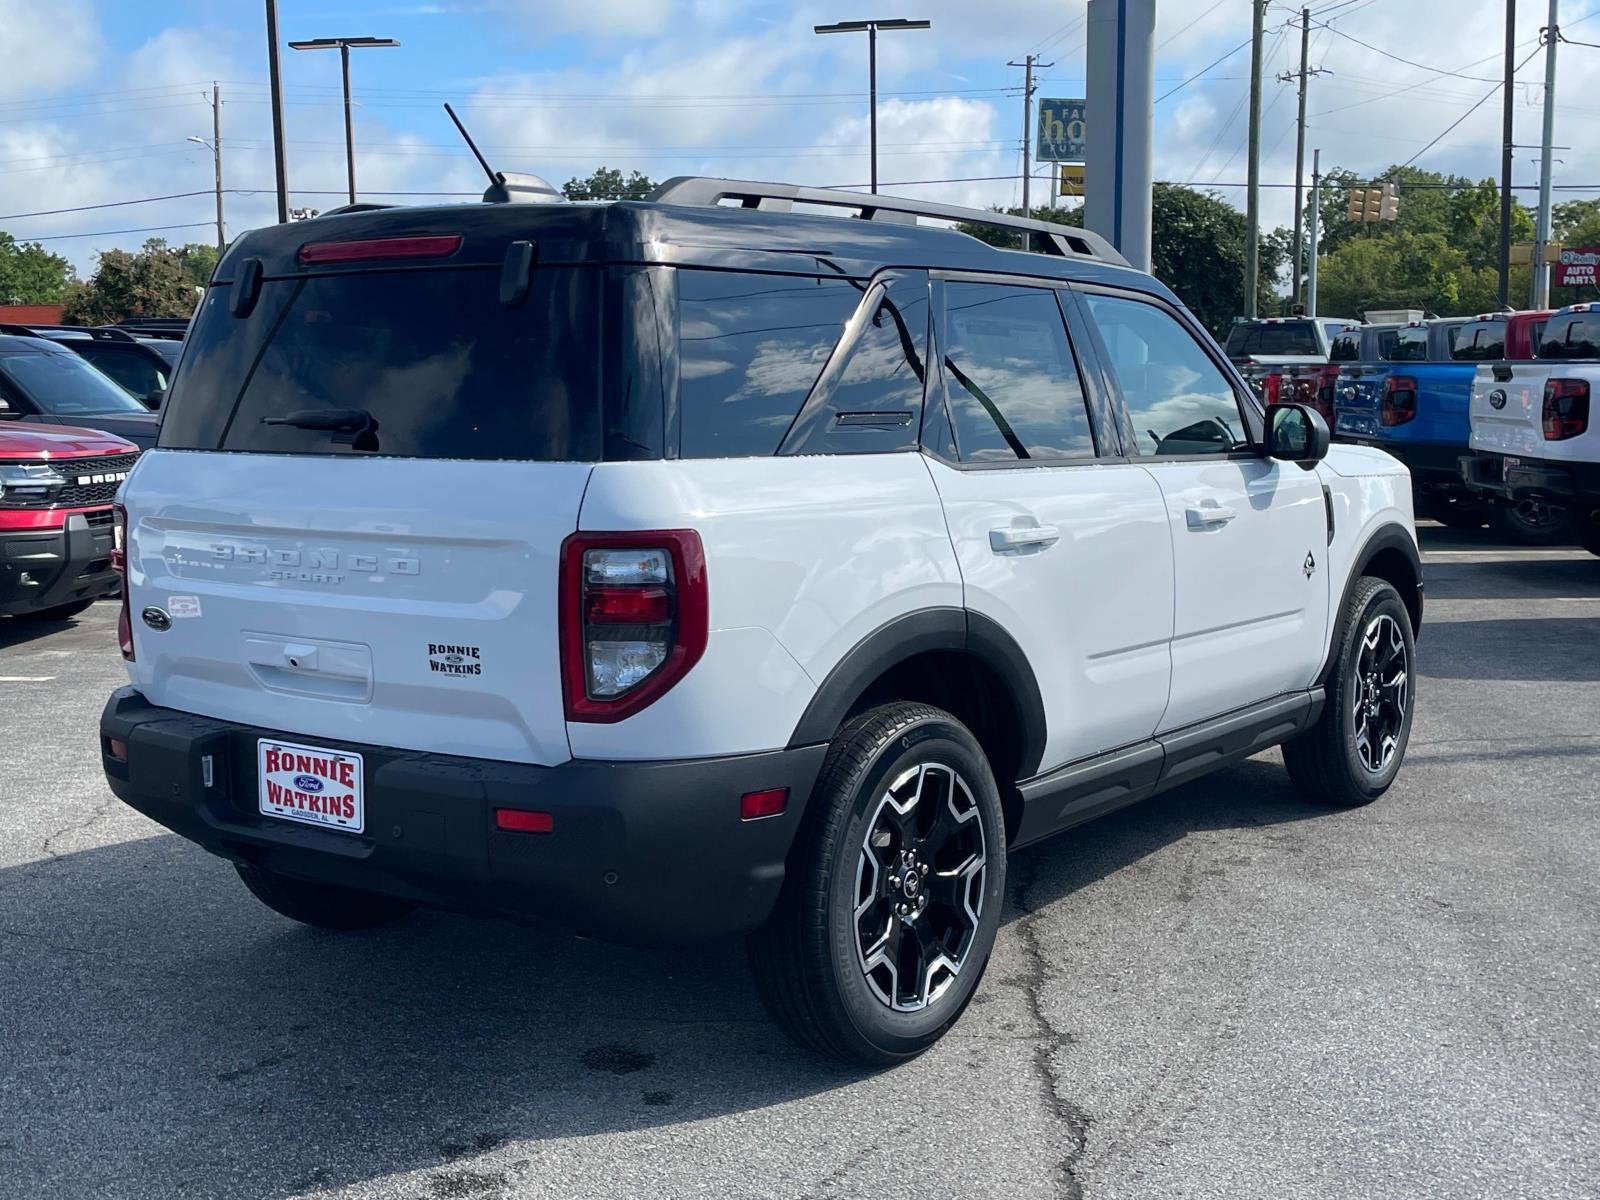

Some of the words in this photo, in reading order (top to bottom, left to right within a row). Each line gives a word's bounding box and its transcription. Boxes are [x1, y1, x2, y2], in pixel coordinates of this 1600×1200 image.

[1043, 109, 1087, 144] ho
[1567, 266, 1594, 275] AUTO
[1563, 276, 1596, 285] PARTS
[77, 471, 130, 485] BRON
[210, 543, 420, 575] BRONCO
[269, 571, 346, 584] SPORT
[428, 643, 480, 660] RONNIE
[429, 659, 481, 675] WATKINS
[265, 749, 354, 790] RONNIE
[298, 778, 321, 791] Ford
[266, 778, 355, 819] WATKINS
